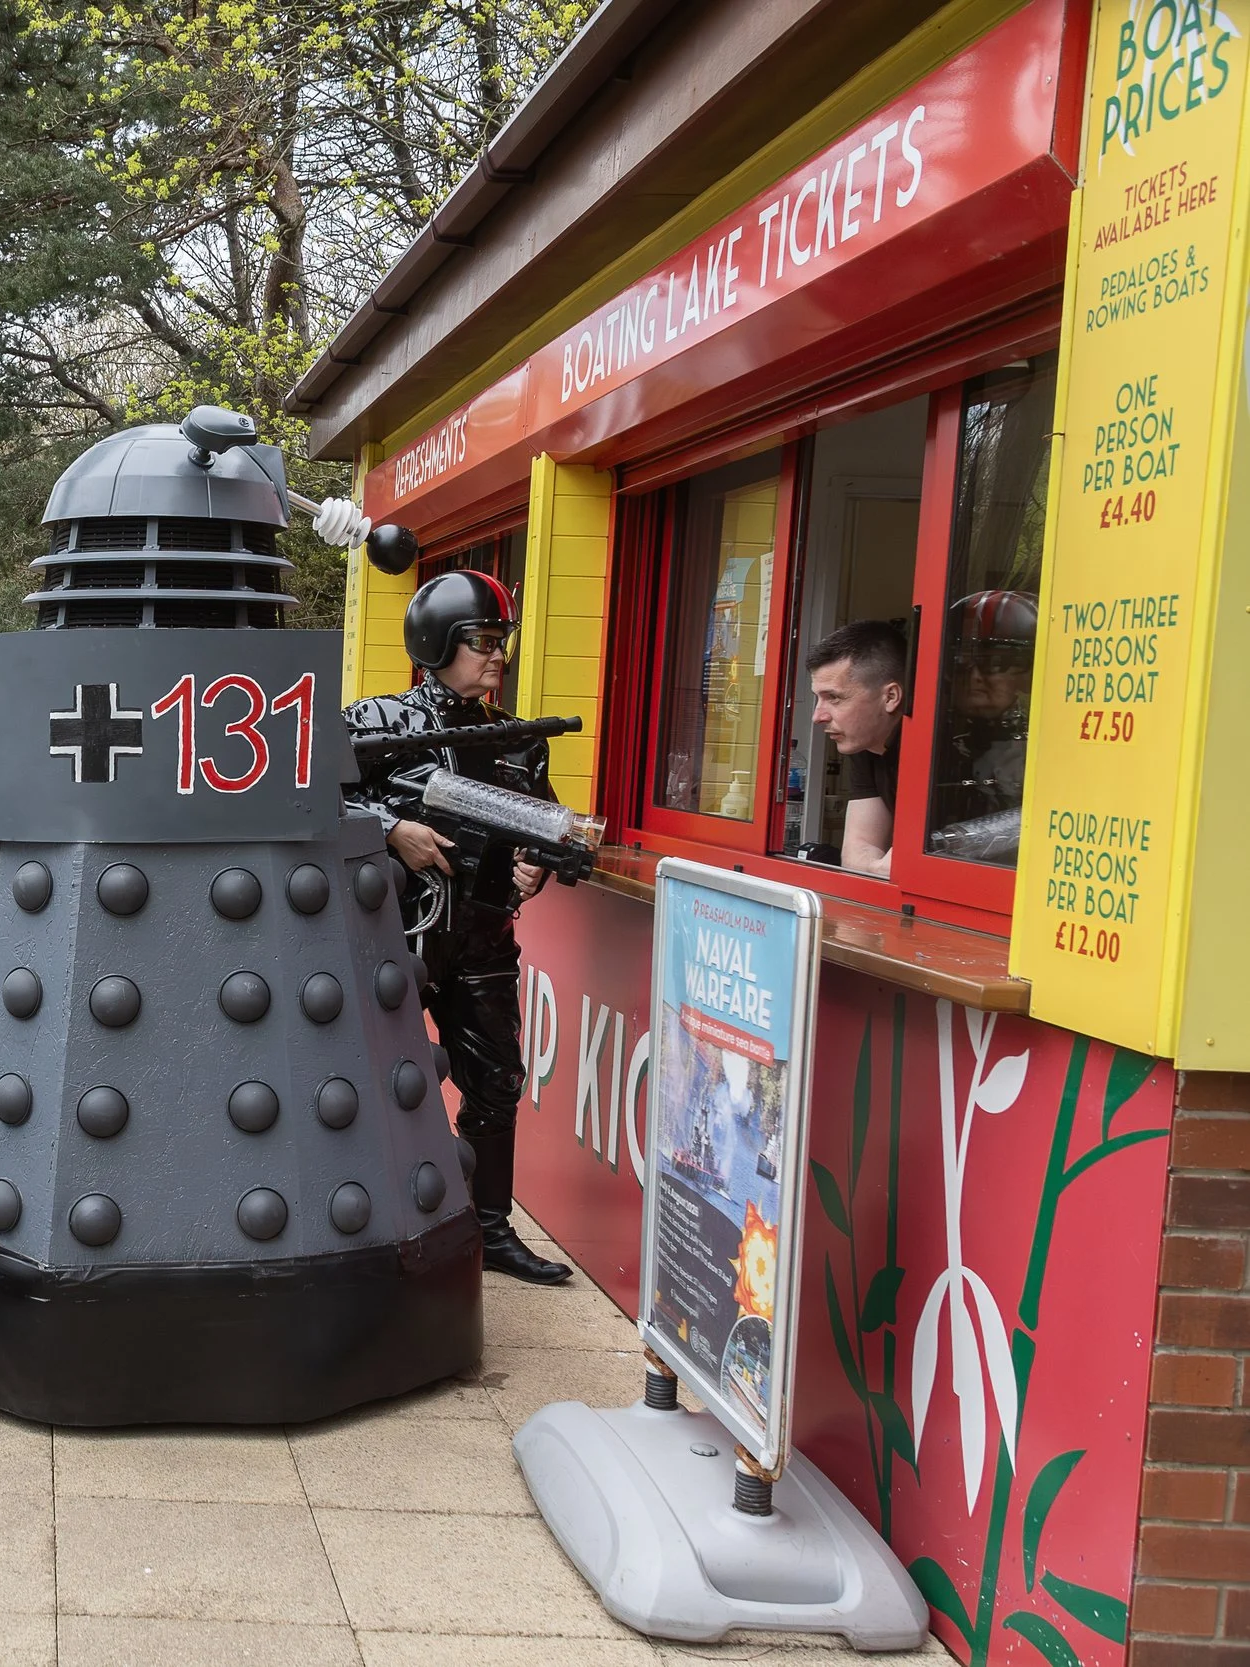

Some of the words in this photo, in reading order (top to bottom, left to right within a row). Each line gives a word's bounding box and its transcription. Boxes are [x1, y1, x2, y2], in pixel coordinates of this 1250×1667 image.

[1117, 0, 1218, 81] BOAT
[1101, 32, 1230, 156] PRICES
[1125, 161, 1187, 211] TICKETS
[1093, 197, 1171, 253] AVAILABLE
[1178, 176, 1218, 216] HERE
[561, 285, 658, 404] BOATING
[665, 226, 742, 343] LAKE
[758, 105, 925, 288] TICKETS
[1101, 249, 1178, 301] PEDALOES
[1186, 244, 1196, 268] &
[1086, 289, 1147, 333] ROWING
[1153, 266, 1209, 309] BOATS
[1116, 374, 1157, 414] ONE
[1095, 408, 1174, 456] PERSON
[394, 414, 467, 500] REFRESHMENTS
[1083, 459, 1115, 494] PER
[1123, 443, 1181, 486] BOAT
[1100, 490, 1156, 529] £4.40
[1063, 595, 1180, 632] TWO/THREE
[1072, 634, 1158, 667] PERSONS
[1065, 672, 1096, 703] PER
[1103, 671, 1160, 703] BOAT
[150, 672, 315, 795] 131
[1079, 711, 1135, 743] £7.50
[1048, 809, 1151, 852] FOUR/FIVE
[1053, 844, 1138, 887] PERSONS
[700, 903, 741, 930] PEASHOLM
[743, 916, 767, 937] PARK
[1046, 878, 1077, 912] PER
[1084, 885, 1140, 923] BOAT
[695, 926, 756, 983] NAVAL
[1055, 921, 1120, 963] £12.00
[685, 961, 772, 1031] WARFARE
[702, 1021, 735, 1045] miniature
[736, 1036, 749, 1051] sea
